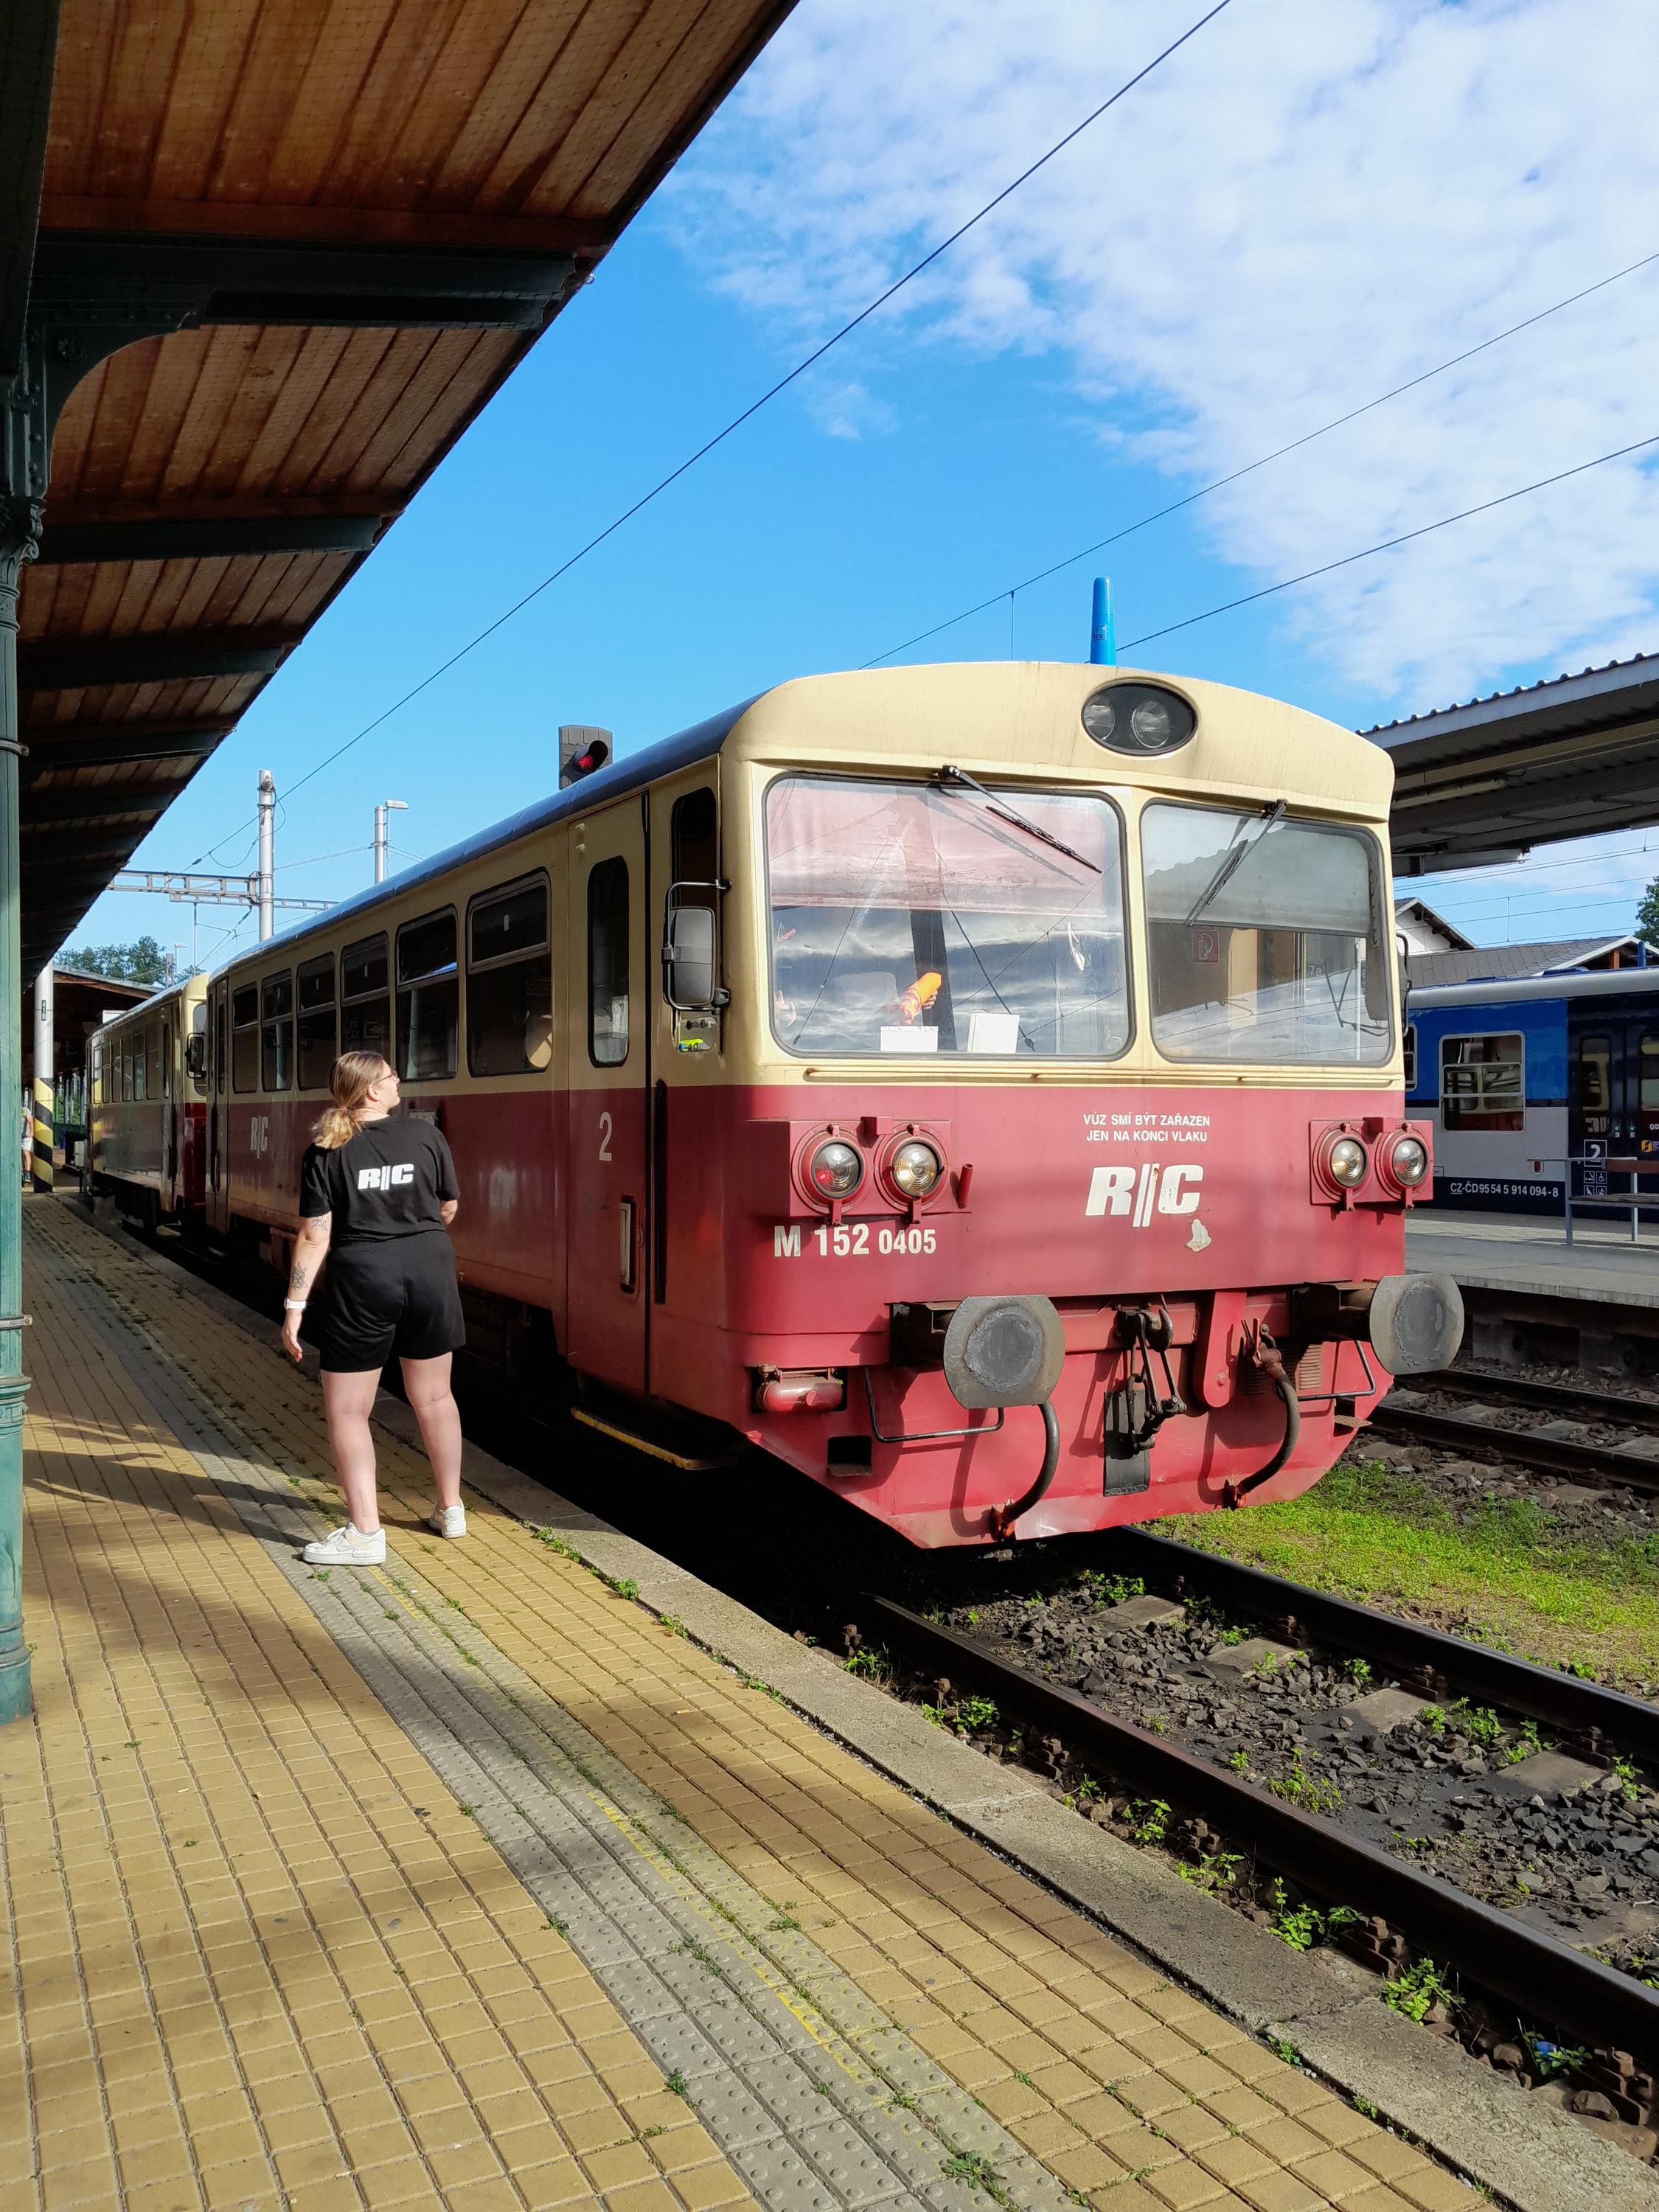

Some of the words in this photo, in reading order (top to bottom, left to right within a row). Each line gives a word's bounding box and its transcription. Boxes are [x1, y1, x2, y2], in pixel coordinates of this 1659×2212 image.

[1083, 1111, 1107, 1125] VŮZ
[1111, 1112, 1131, 1125] SMÍ
[1135, 1112, 1158, 1126] BÝT
[1160, 1113, 1210, 1127] ZAŘAZEN
[599, 1111, 612, 1161] 2
[1086, 1130, 1109, 1141] JEN
[1113, 1130, 1130, 1141] NA
[1133, 1130, 1169, 1141] KONCI
[1172, 1131, 1208, 1142] VLAKU
[1590, 1144, 1601, 1163] 2
[1490, 1184, 1501, 1194] 54
[1503, 1185, 1509, 1194] 5
[1512, 1185, 1528, 1195] 914
[774, 1225, 801, 1256] M
[814, 1222, 870, 1256] 152
[878, 1229, 936, 1254] 0405
